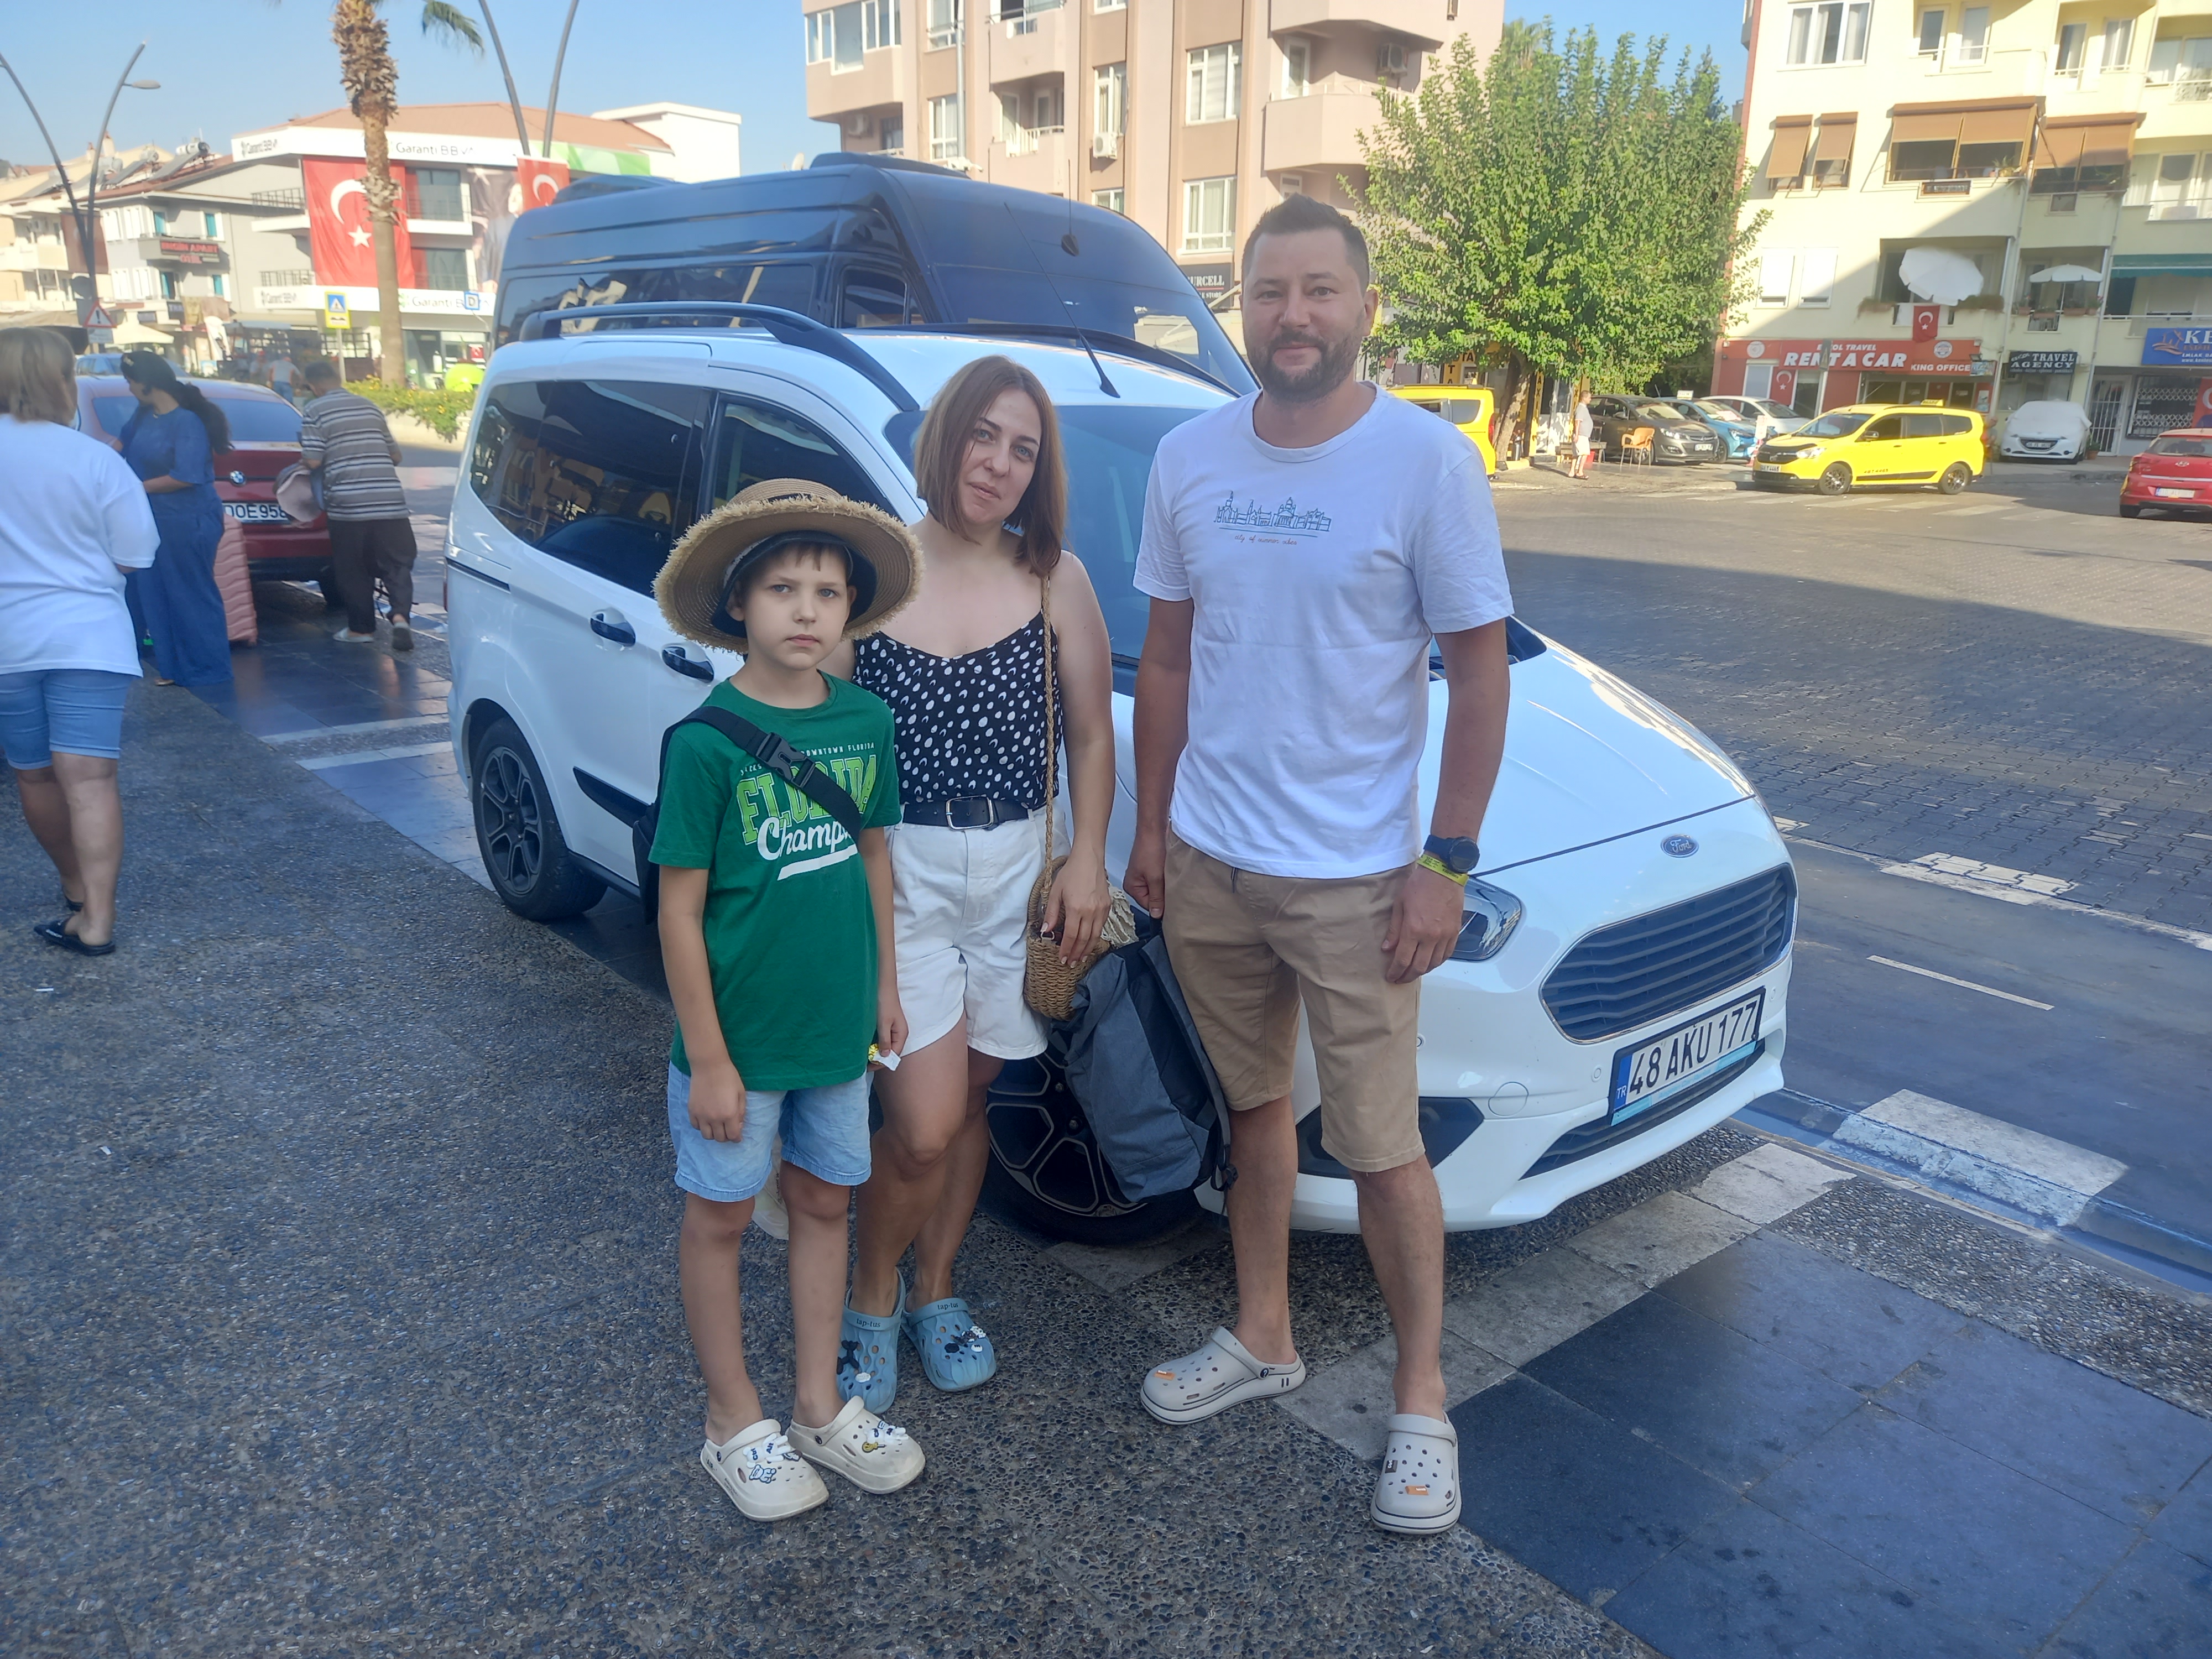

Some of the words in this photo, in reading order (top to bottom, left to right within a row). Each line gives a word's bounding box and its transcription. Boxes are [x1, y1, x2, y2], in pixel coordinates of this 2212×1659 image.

[396, 142, 437, 154] Garanti
[1188, 275, 1224, 286] URCELL
[413, 296, 452, 307] Garanti
[468, 296, 476, 306] D
[1841, 353, 1856, 367] A
[1862, 352, 1907, 368] CAR
[1235, 534, 1245, 543] city
[1249, 535, 1256, 543] of
[848, 742, 875, 752] FLORIDA
[1670, 839, 1692, 853] Ford
[1617, 1085, 1627, 1099] TR
[1629, 1047, 1661, 1095] 48
[1665, 1021, 1713, 1081] AKU
[1718, 1000, 1757, 1054] 177
[938, 1302, 958, 1310] tap-tus
[857, 1318, 881, 1328] tap-tus
